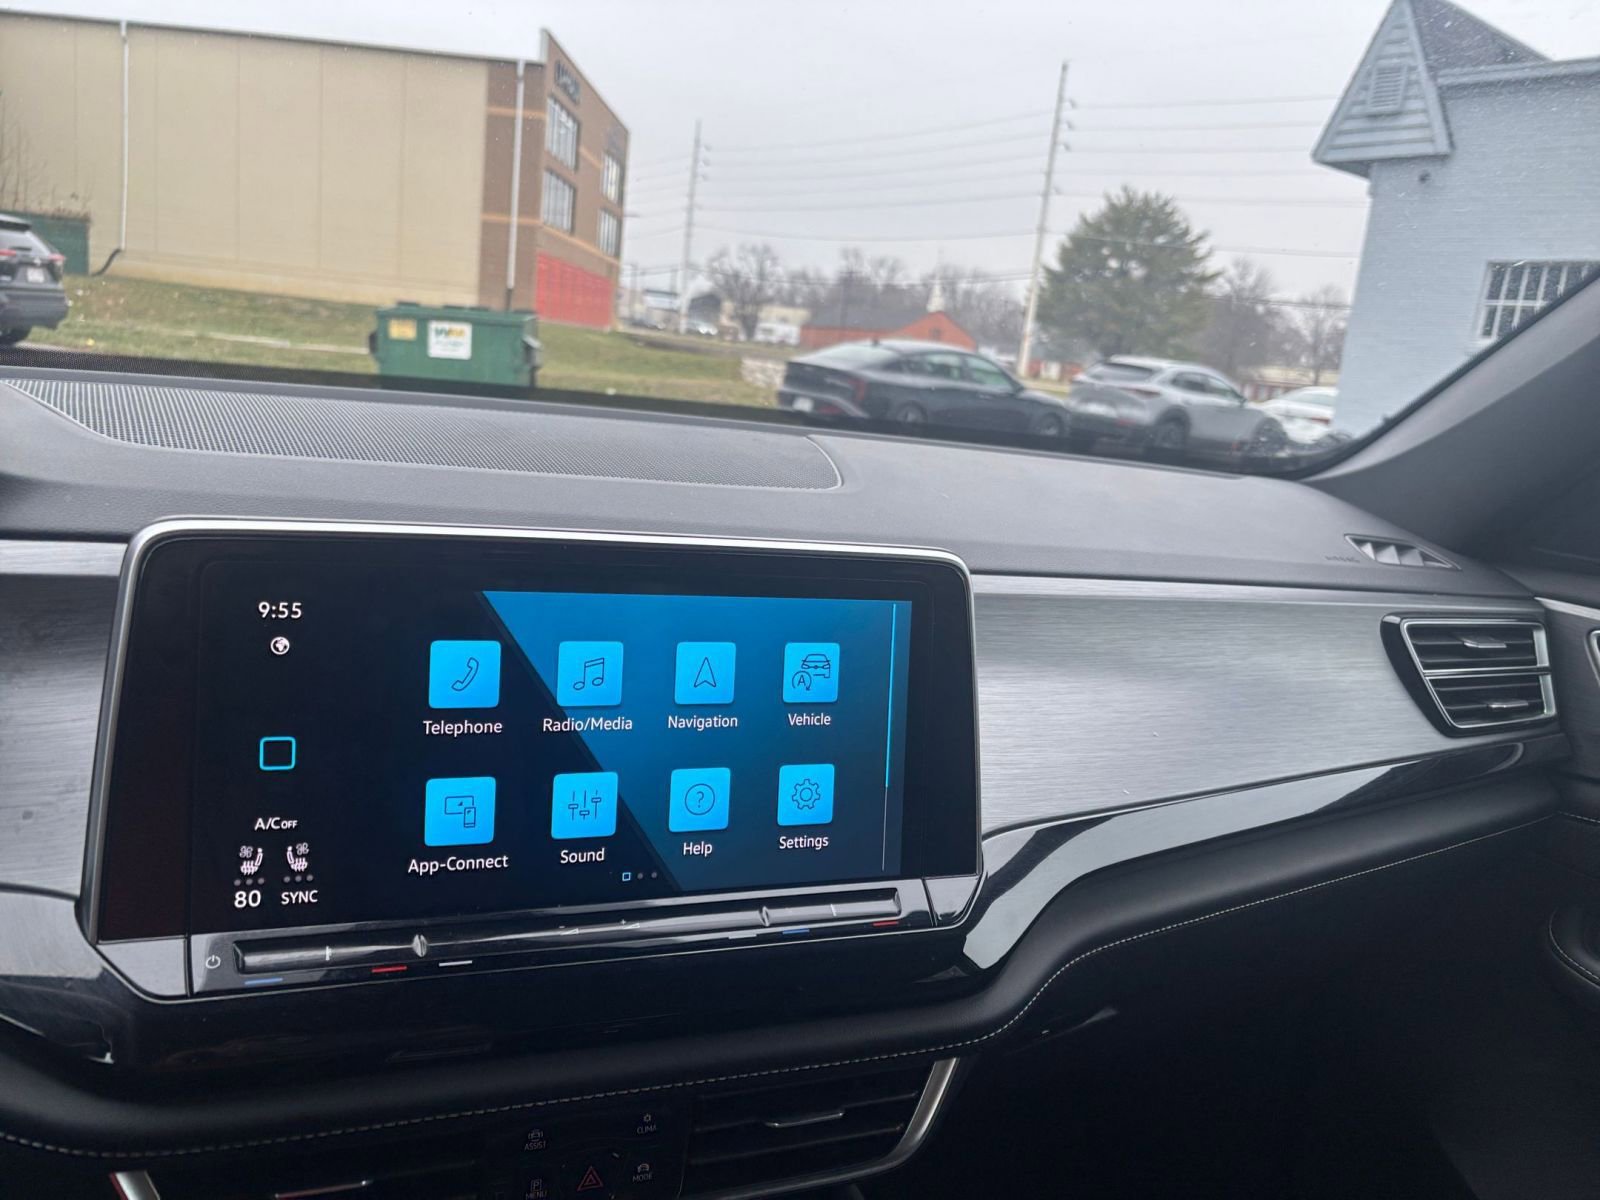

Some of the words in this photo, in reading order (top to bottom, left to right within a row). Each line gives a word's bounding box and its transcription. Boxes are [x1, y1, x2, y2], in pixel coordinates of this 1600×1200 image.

[258, 601, 302, 619] 9:55
[542, 716, 633, 732] Radio/Media
[667, 714, 738, 731] Navigation
[787, 712, 831, 726] Vehicle
[422, 719, 503, 738] Telephone
[683, 841, 713, 857] Help
[779, 834, 829, 850] Settings
[560, 847, 605, 864] Sound
[407, 854, 509, 875] App-Connect
[234, 889, 262, 908] 80
[281, 889, 318, 905] SYNC
[636, 1124, 657, 1135] CLIMA
[524, 1140, 546, 1151] ASSIST
[632, 1172, 653, 1183] MODE
[525, 1190, 547, 1200] MENU
